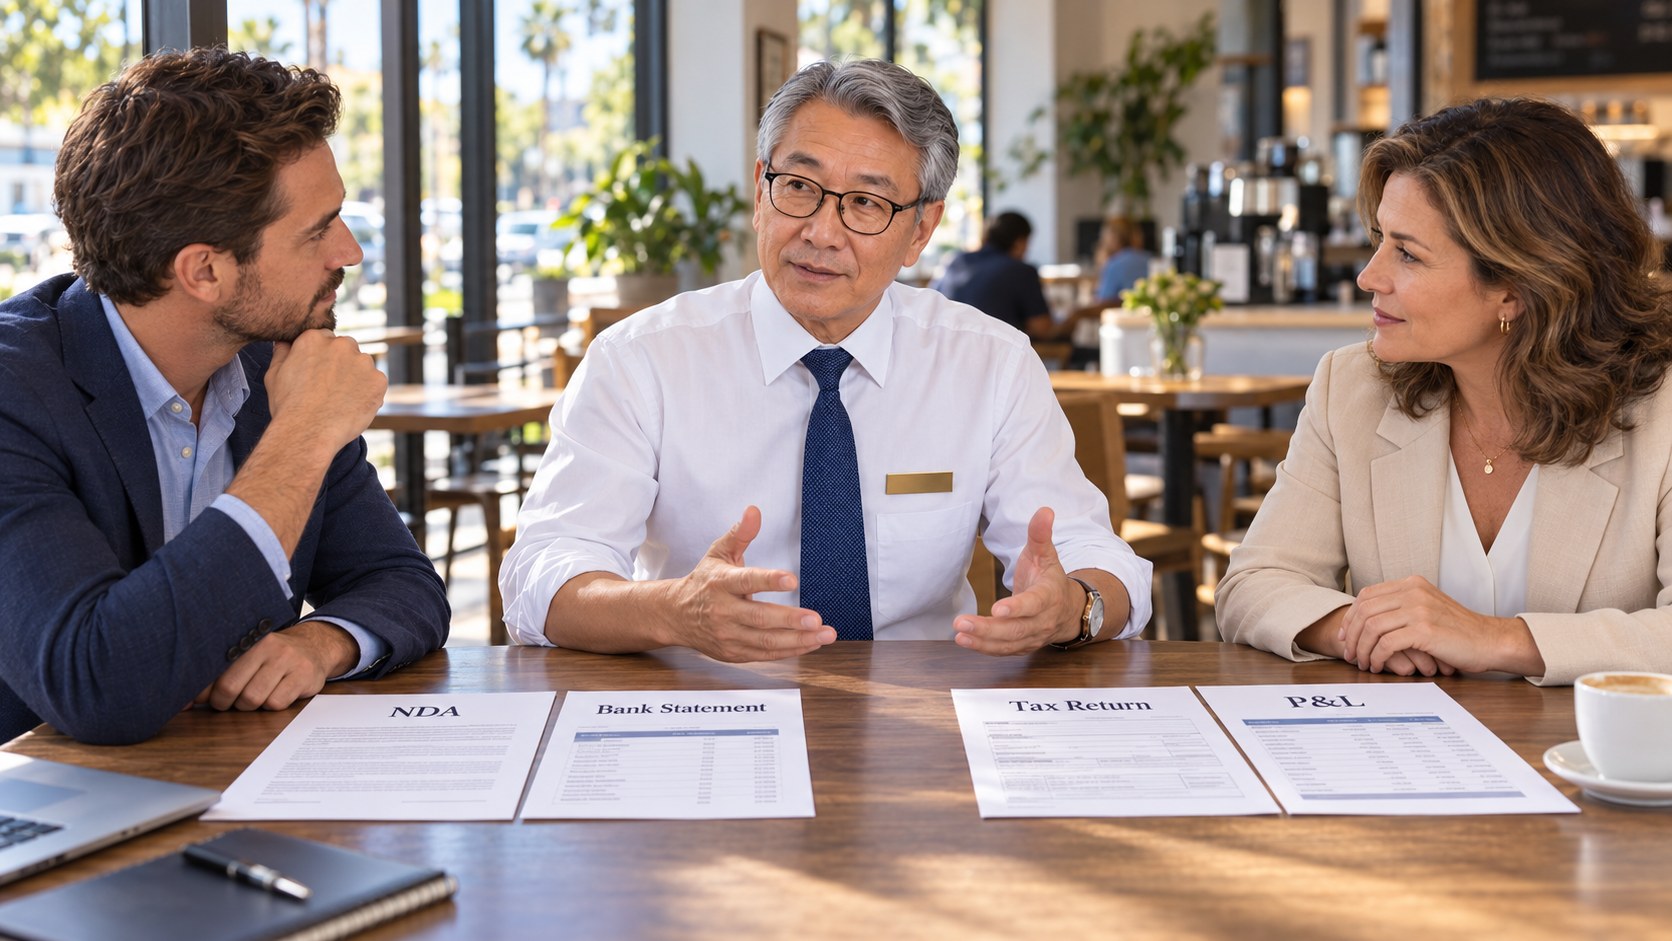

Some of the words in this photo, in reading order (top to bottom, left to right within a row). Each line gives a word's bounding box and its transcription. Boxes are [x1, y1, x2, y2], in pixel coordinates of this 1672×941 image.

[1008, 700, 1059, 712] Tax
[1064, 700, 1153, 711] Return
[1285, 695, 1366, 708] P&L
[388, 705, 461, 718] NDA
[596, 703, 654, 715] Bank
[659, 702, 766, 714] Statement
